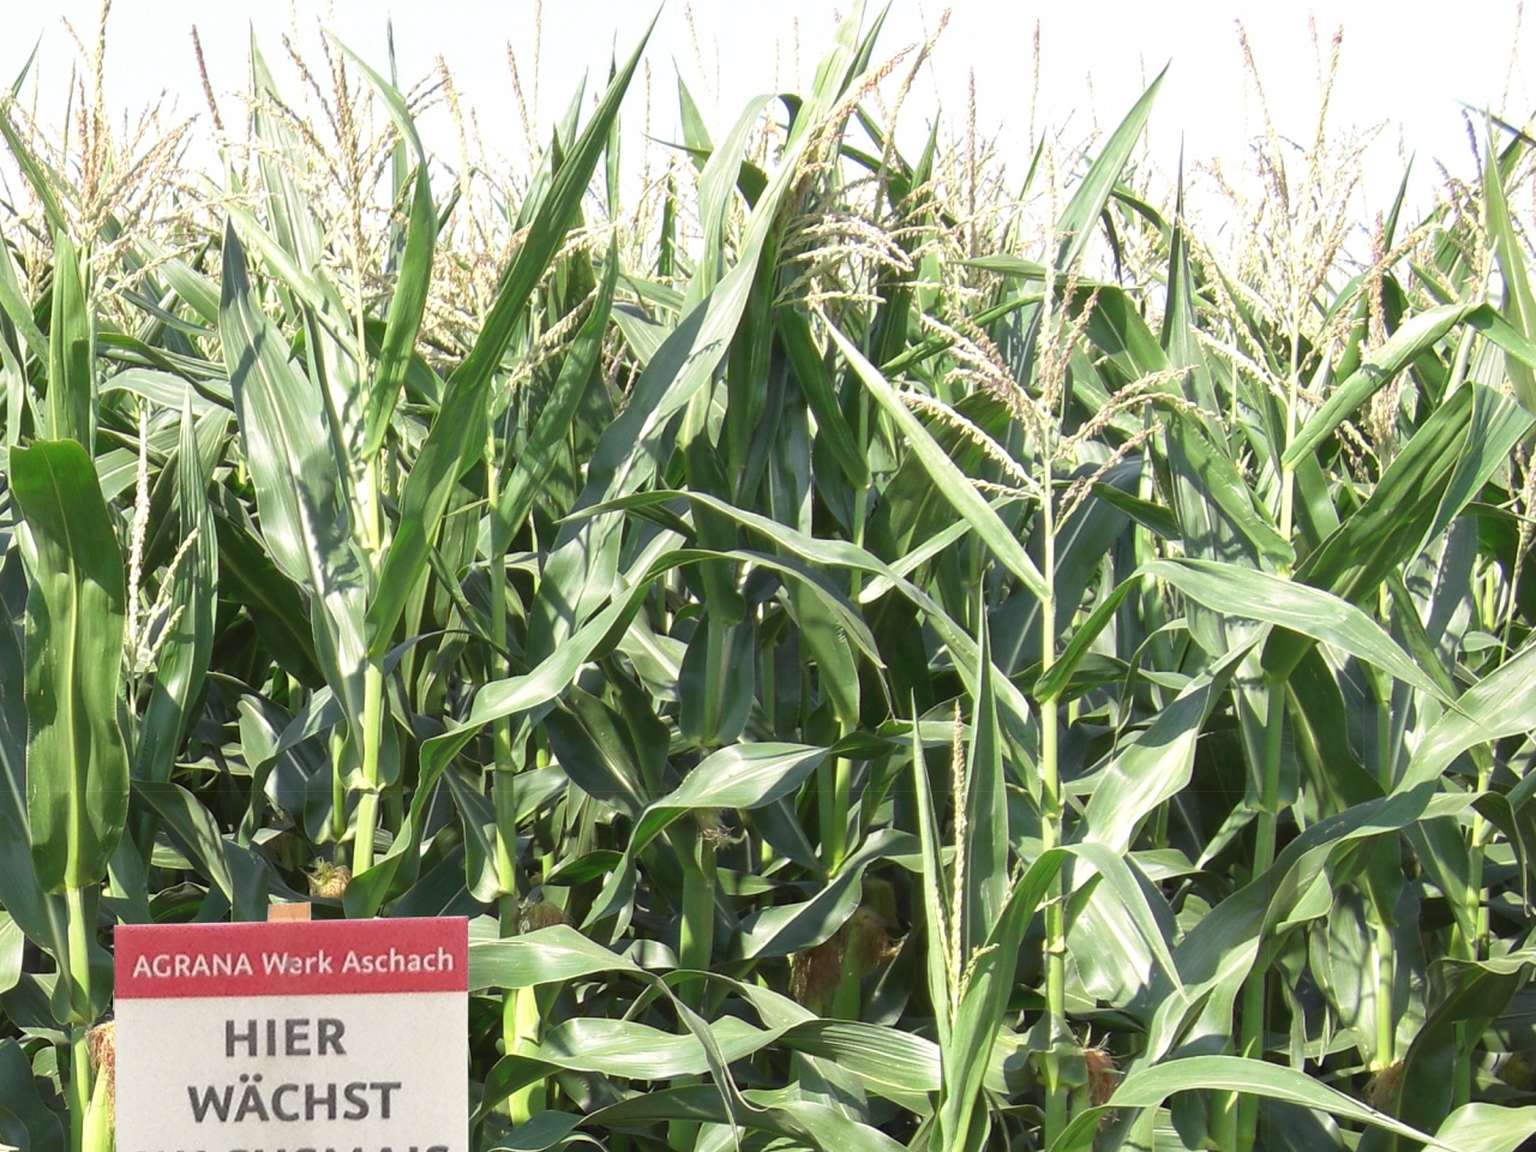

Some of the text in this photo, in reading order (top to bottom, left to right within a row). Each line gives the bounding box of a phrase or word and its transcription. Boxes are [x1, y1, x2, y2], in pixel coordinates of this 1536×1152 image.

[132, 946, 455, 979] AGRANA Werk Aschach
[225, 1018, 346, 1058] HIER
[187, 1073, 402, 1123] WÄCHST
